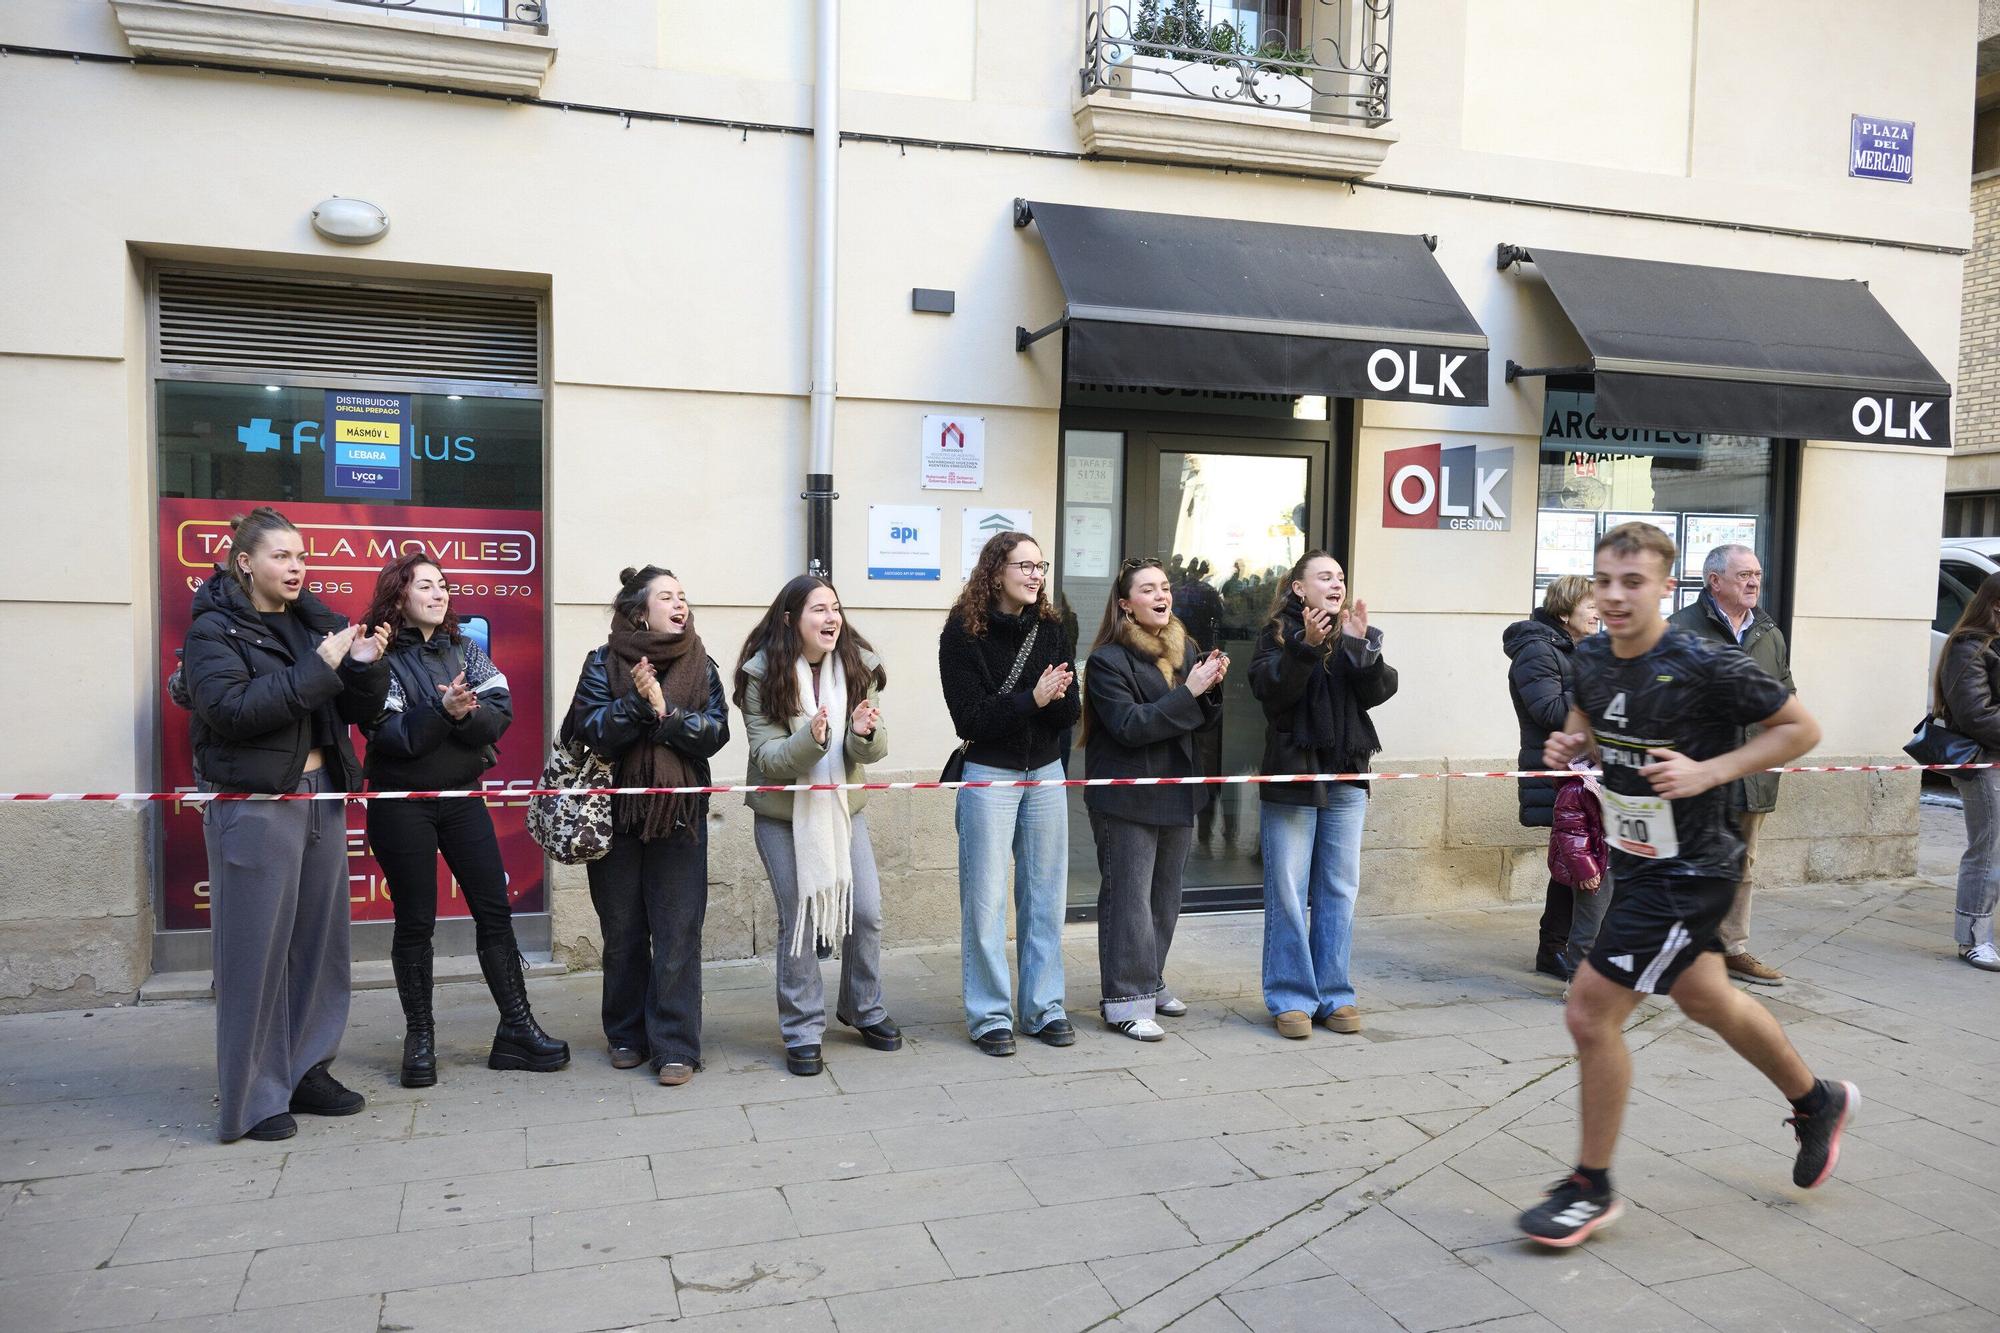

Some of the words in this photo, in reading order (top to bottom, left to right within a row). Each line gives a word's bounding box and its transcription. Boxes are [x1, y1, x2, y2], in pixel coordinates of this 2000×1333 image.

[1862, 123, 1909, 140] PLAZA
[1874, 139, 1900, 150] DEL
[1854, 149, 1911, 174] MERCADO
[1367, 348, 1468, 398] OLK
[335, 405, 365, 413] OFICIAL
[365, 407, 400, 415] PREPAGO
[336, 396, 400, 407] DISTRIBUIDOR
[1851, 396, 1934, 441] OLK
[348, 450, 386, 460] LEBARA
[352, 471, 376, 481] Lyca
[1390, 464, 1508, 518] OLK
[1450, 517, 1502, 531] GESTIÓN
[890, 527, 918, 544] api
[367, 538, 522, 562] MOVILES
[308, 581, 353, 594] 896
[494, 585, 531, 597] 870
[1603, 692, 1629, 728] 4
